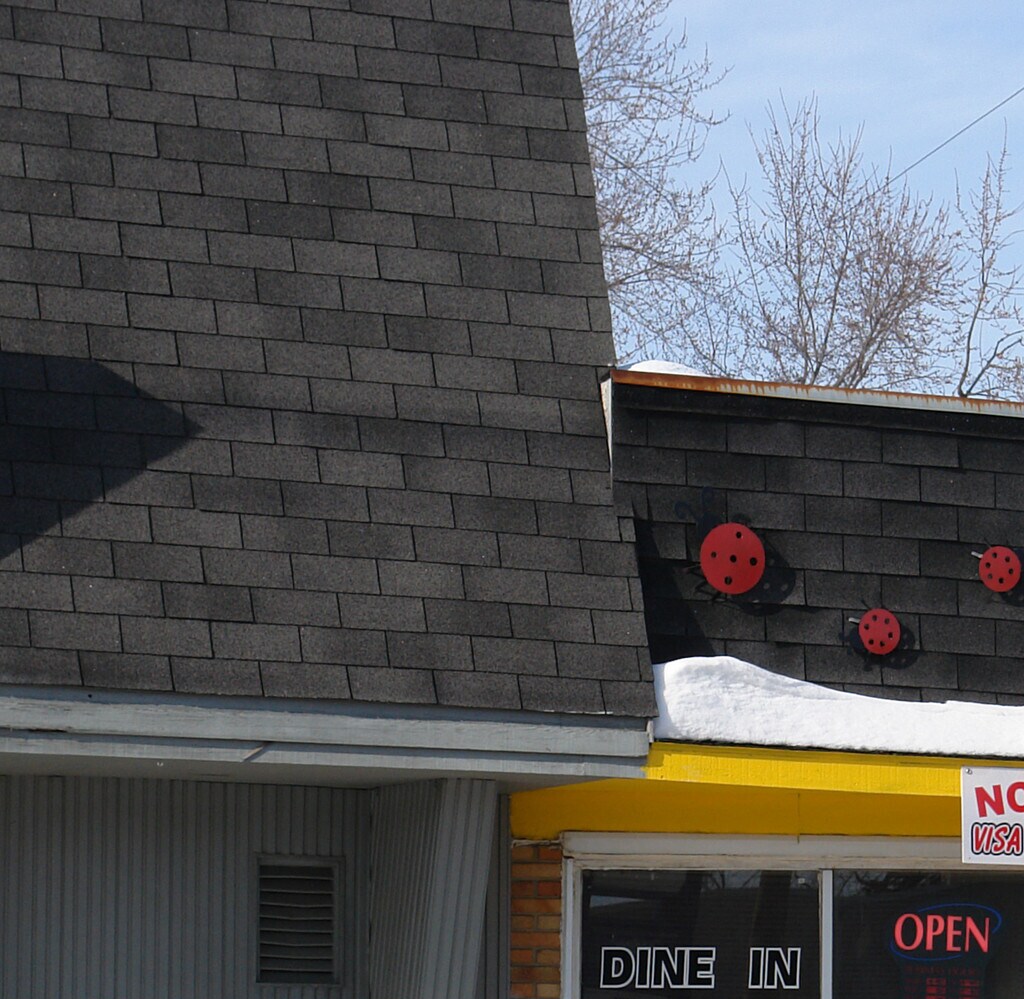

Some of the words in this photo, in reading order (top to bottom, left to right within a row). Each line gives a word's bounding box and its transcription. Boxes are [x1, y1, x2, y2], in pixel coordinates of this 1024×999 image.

[971, 822, 1023, 856] VISA
[893, 912, 991, 953] OPEN
[600, 946, 716, 989] DINE
[748, 946, 801, 989] IN
